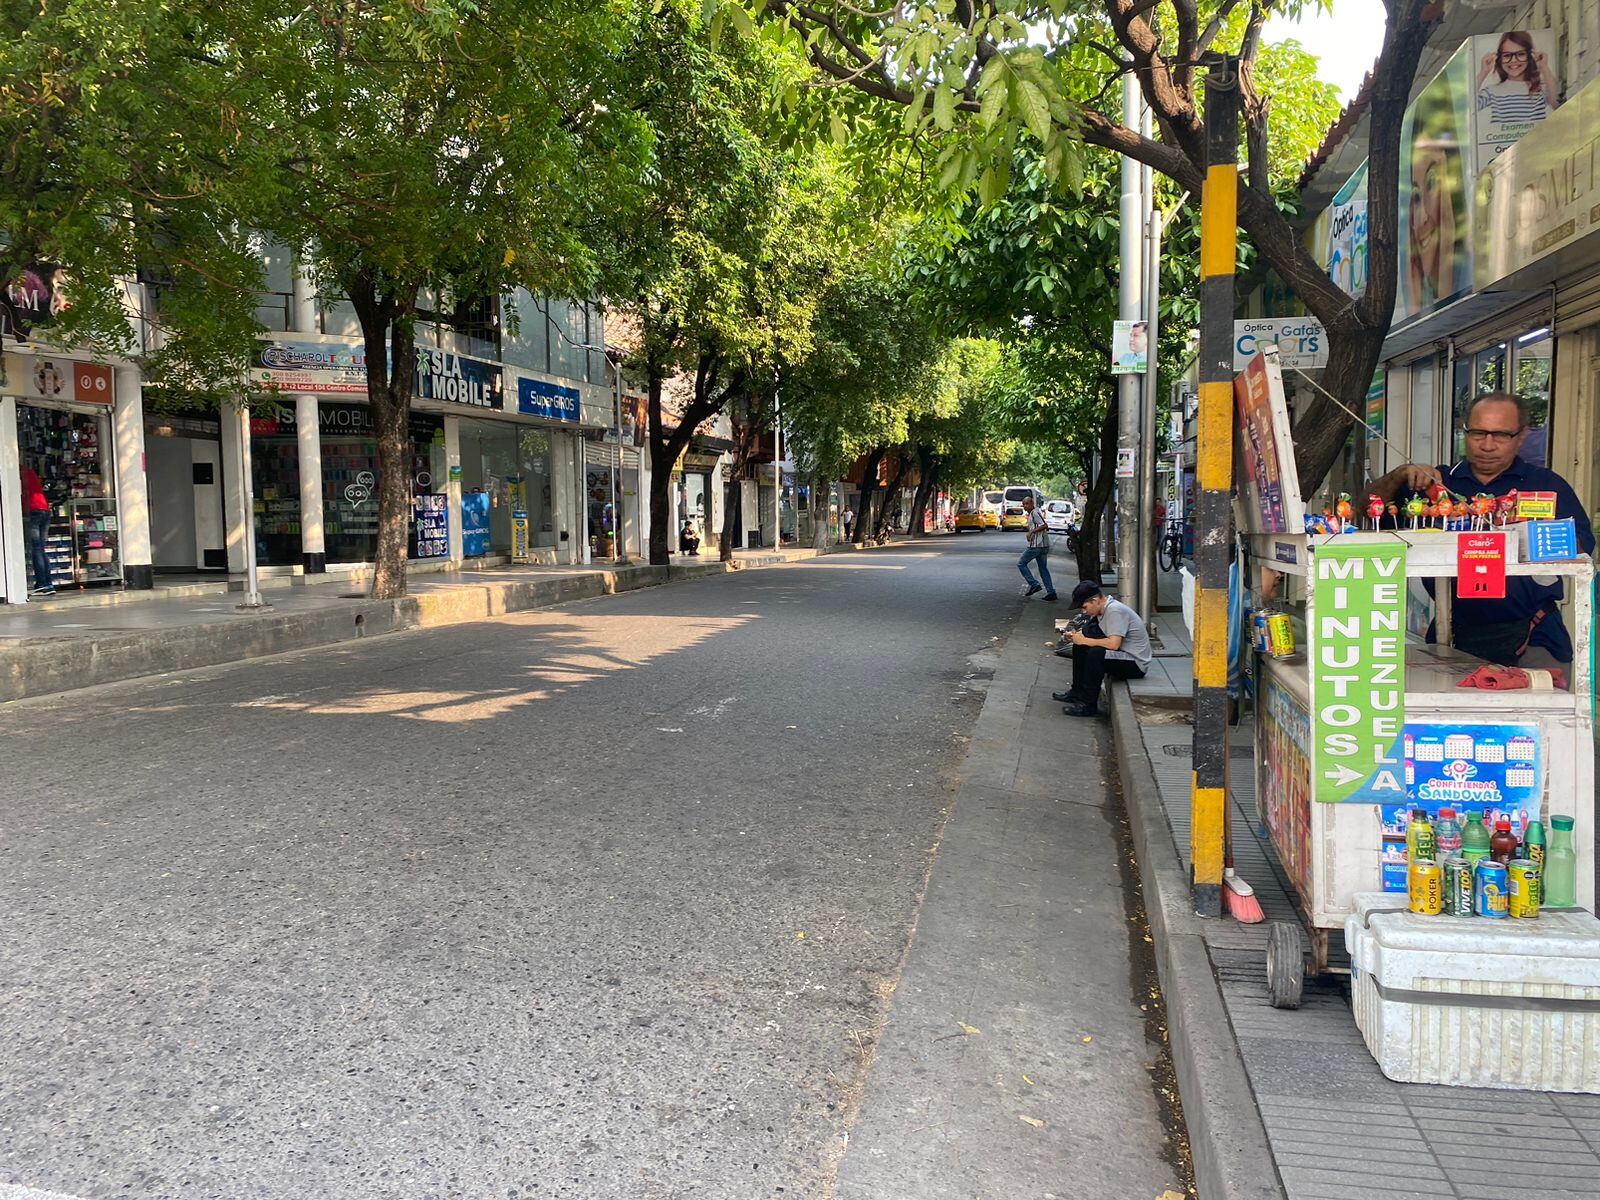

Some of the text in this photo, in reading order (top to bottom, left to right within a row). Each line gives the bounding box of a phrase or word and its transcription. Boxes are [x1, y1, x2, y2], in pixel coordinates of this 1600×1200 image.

[1501, 123, 1534, 131] Examen
[1333, 203, 1354, 240] Óptica
[1244, 323, 1273, 333] Óptica
[432, 374, 491, 407] MOBILE
[530, 390, 575, 412] SuperGIROS
[320, 410, 374, 427] MOBIL
[424, 528, 447, 538] MOBILE
[1468, 538, 1492, 547] Claro
[1318, 558, 1364, 757] MINUTOS
[1369, 557, 1402, 792] VENEZUELA
[1418, 784, 1503, 802] SANDOVAL
[1428, 779, 1497, 790] CONFITIENDAS
[1429, 878, 1437, 910] POKER
[1460, 868, 1470, 914] VIVE100
